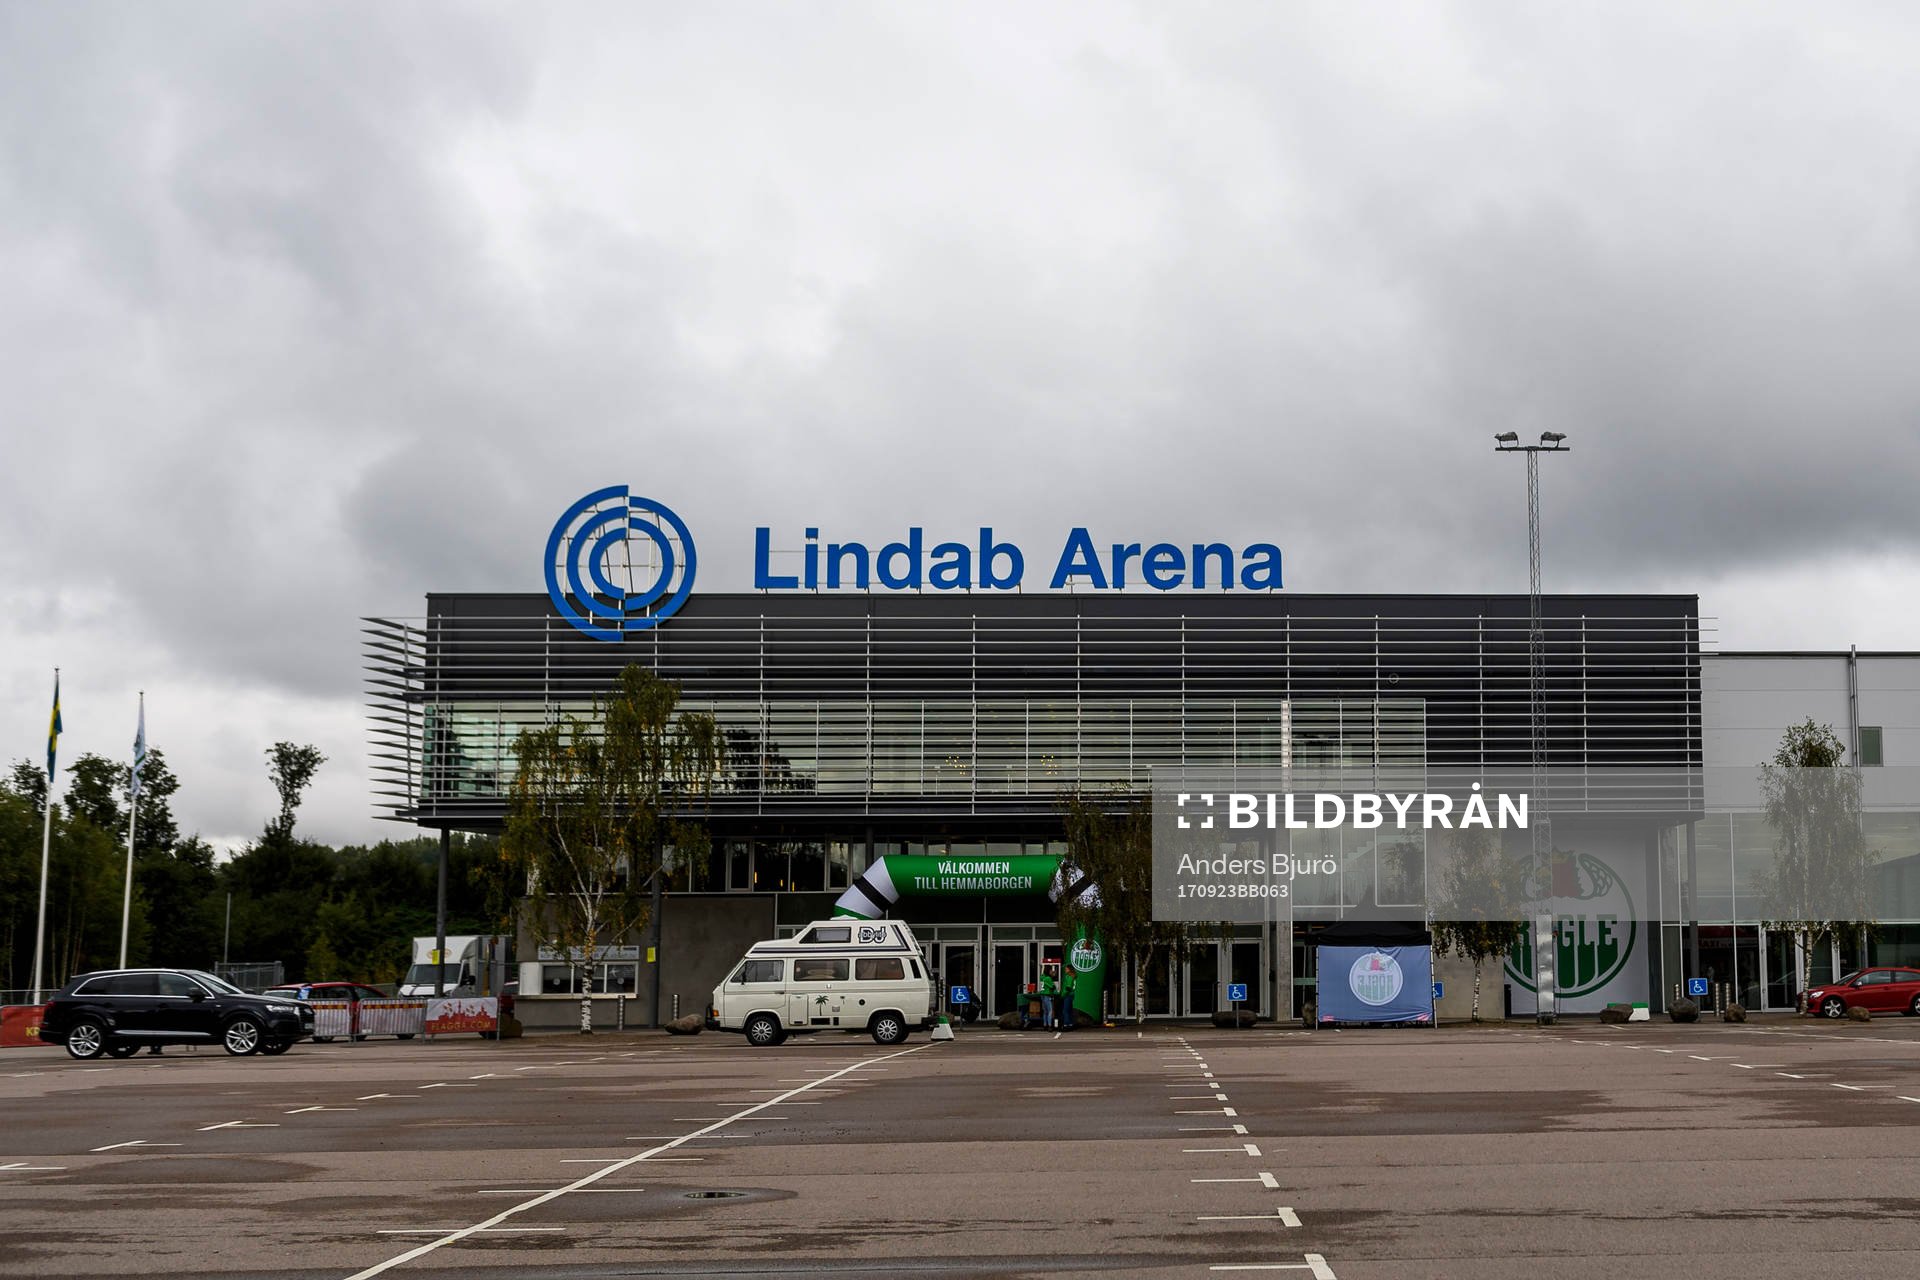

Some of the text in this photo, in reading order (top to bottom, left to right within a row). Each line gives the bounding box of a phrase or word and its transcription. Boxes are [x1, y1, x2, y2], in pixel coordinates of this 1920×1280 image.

[753, 527, 1284, 590] Lindab Arena
[938, 860, 1010, 875] VÄLKOMMEN
[914, 875, 1032, 890] TILL HEMMABORGEN
[859, 926, 886, 944] DJ
[1511, 909, 1619, 988] RGLE
